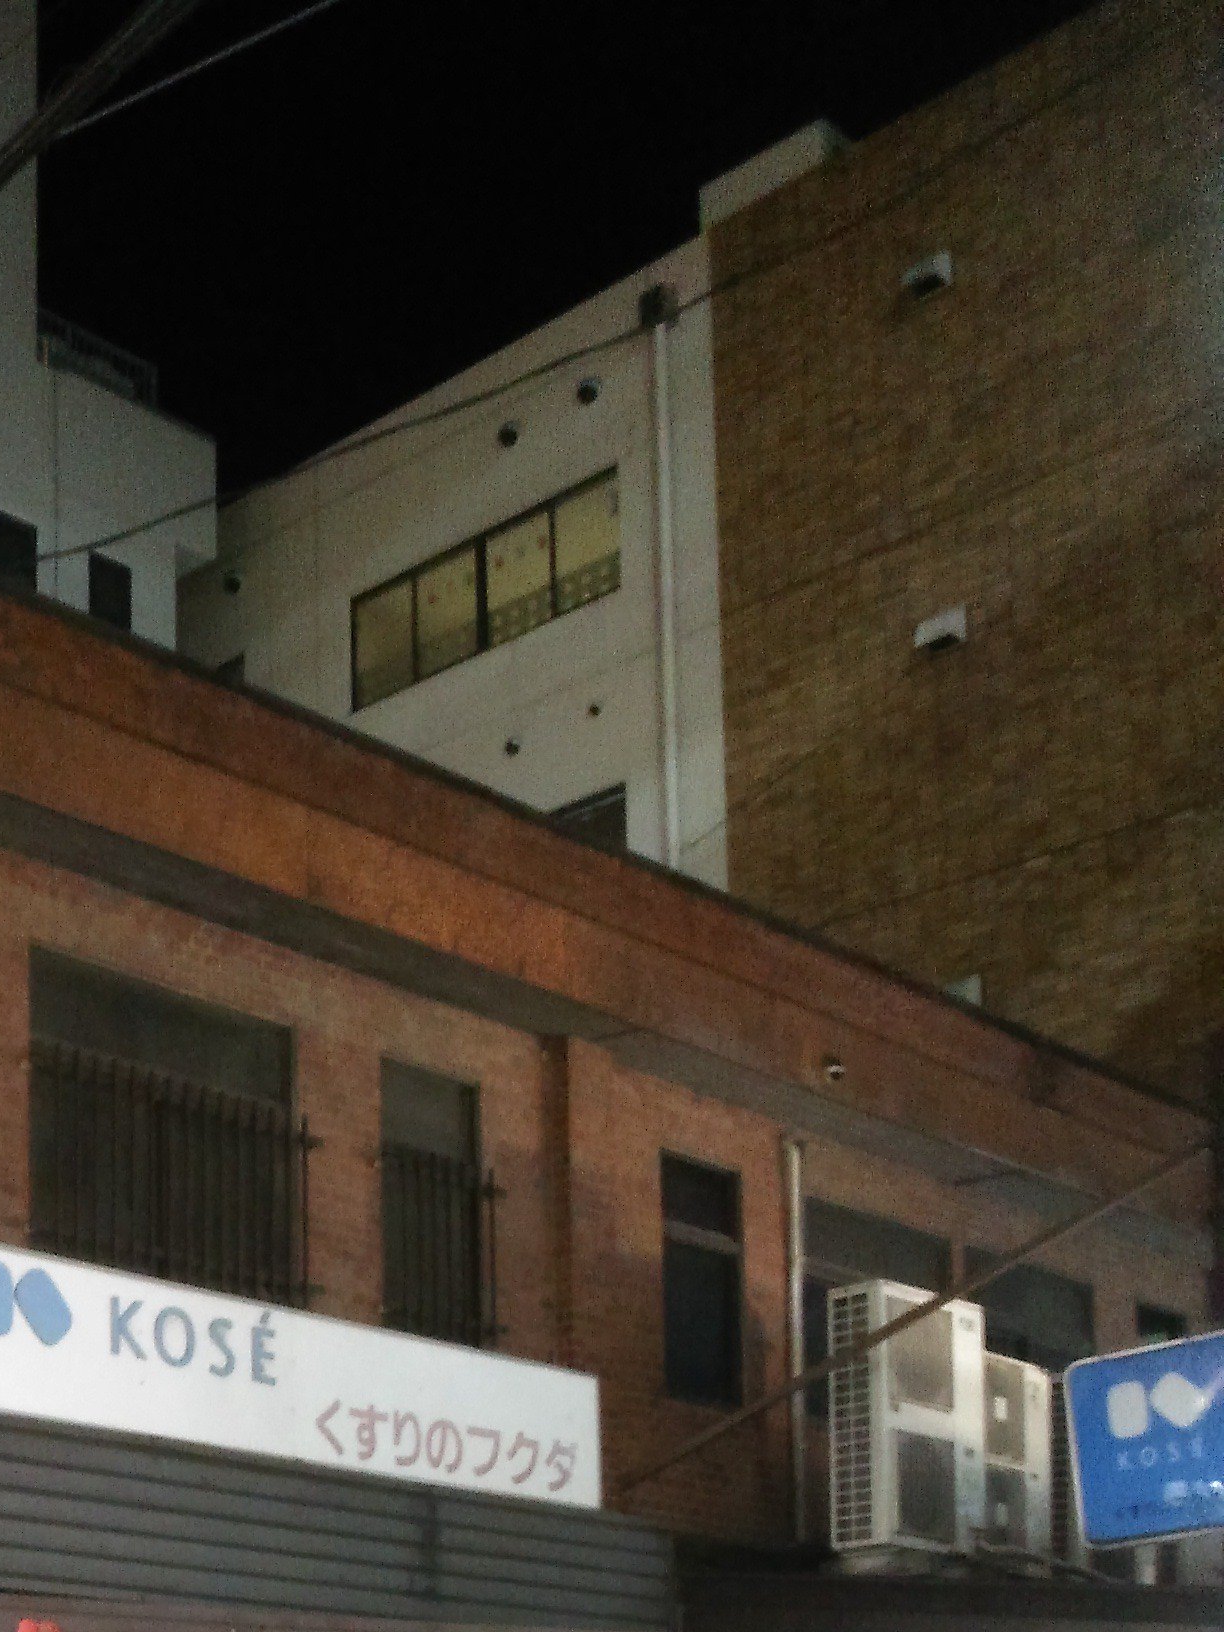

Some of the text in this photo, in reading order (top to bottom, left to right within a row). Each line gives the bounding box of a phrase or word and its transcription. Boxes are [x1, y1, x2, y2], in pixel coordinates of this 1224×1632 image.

[109, 1295, 278, 1387] KOSÉ
[314, 1399, 579, 1493] くすりのフクダ
